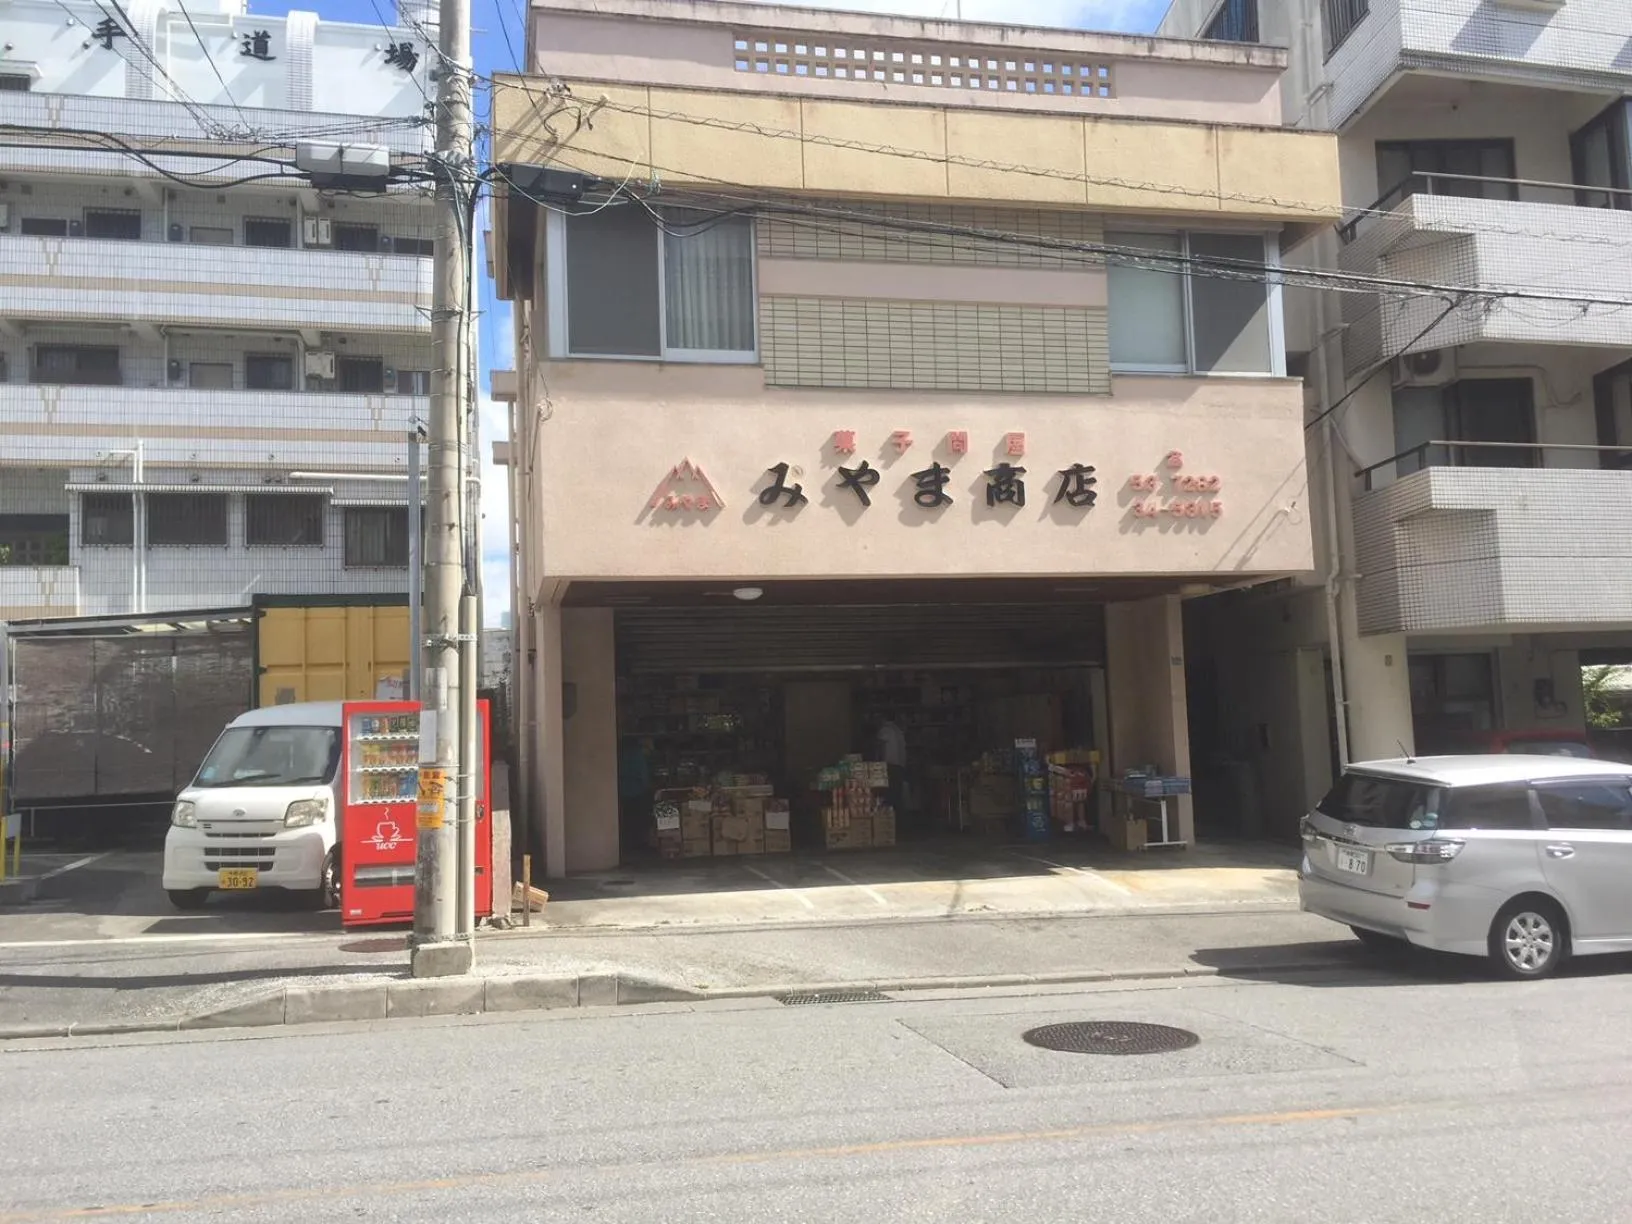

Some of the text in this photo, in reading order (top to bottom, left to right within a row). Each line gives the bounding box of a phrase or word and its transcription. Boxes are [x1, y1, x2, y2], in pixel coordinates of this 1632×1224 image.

[758, 460, 1098, 509] みやま商店
